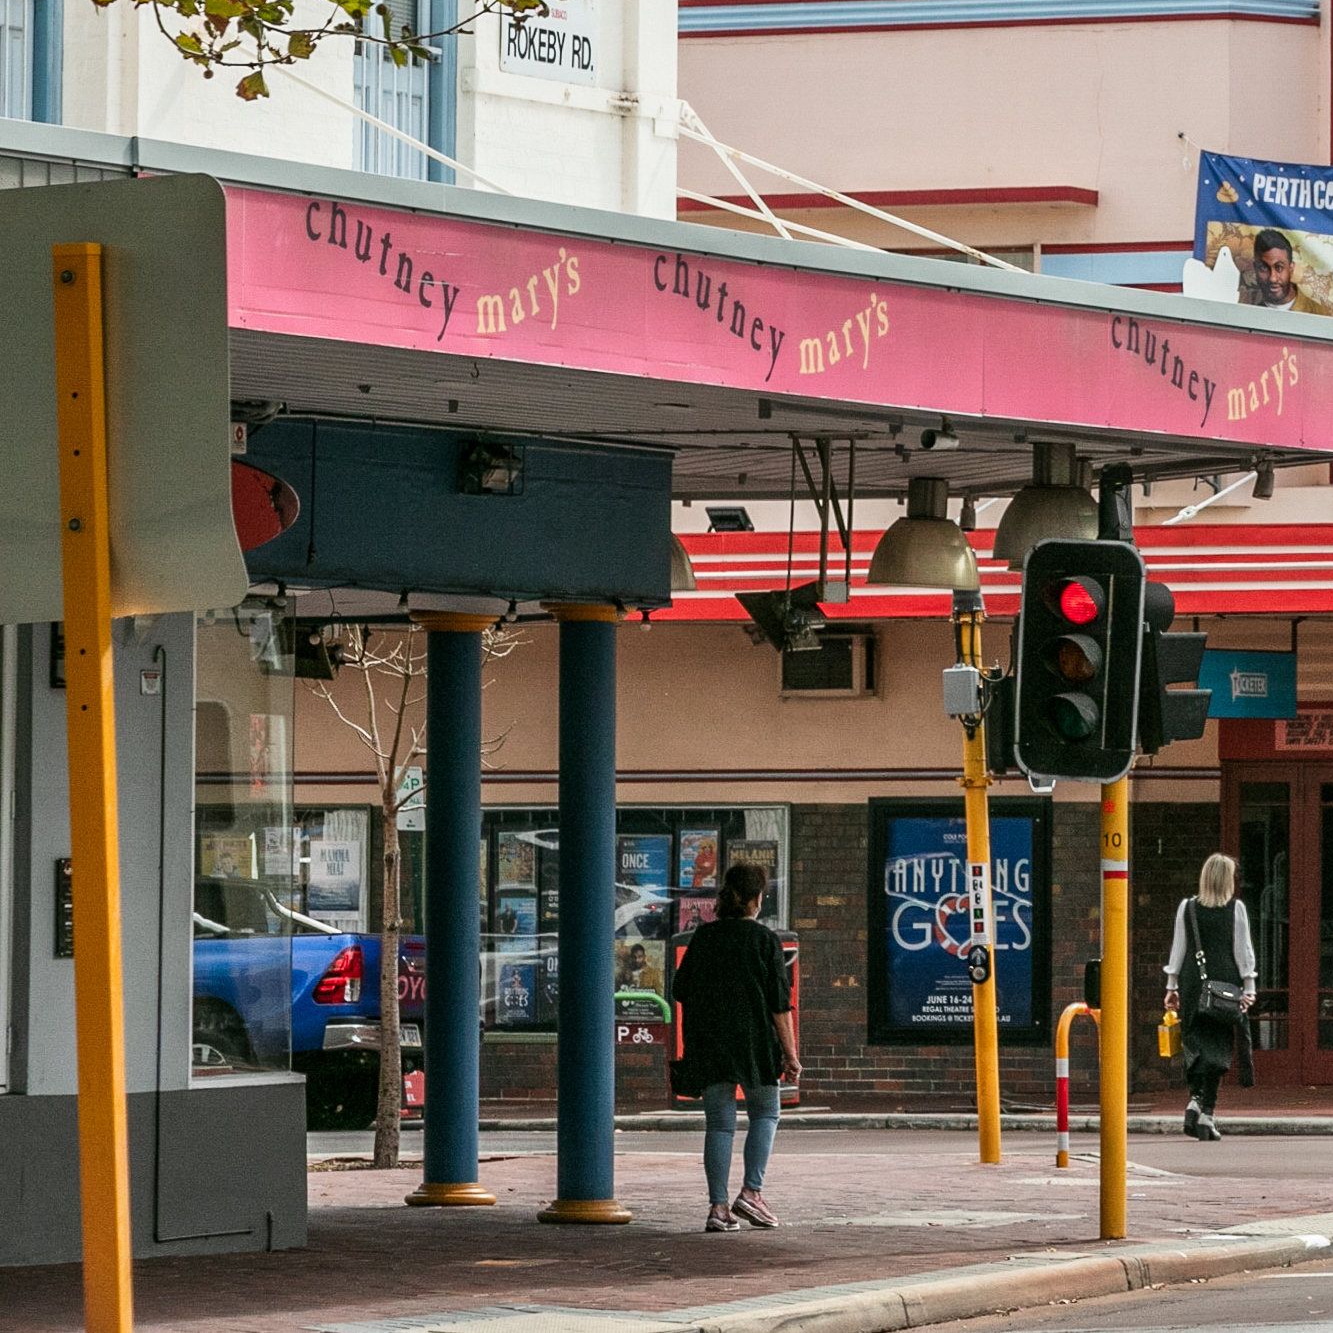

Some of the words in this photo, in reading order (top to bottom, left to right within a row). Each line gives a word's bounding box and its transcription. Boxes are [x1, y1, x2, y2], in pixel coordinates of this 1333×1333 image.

[507, 22, 566, 66] ROKEBY
[571, 34, 594, 71] RD.
[1253, 173, 1311, 208] PERTH
[305, 201, 460, 342] chutney
[475, 247, 581, 334] mary's
[653, 254, 785, 382] chutney
[799, 293, 890, 374] mary's
[1111, 316, 1216, 428] chutney
[1227, 346, 1299, 420] mary's
[1103, 833, 1122, 848] 10
[622, 853, 649, 869] ONCE
[893, 858, 1030, 893] ANYTNG
[926, 995, 948, 1005] JUNE
